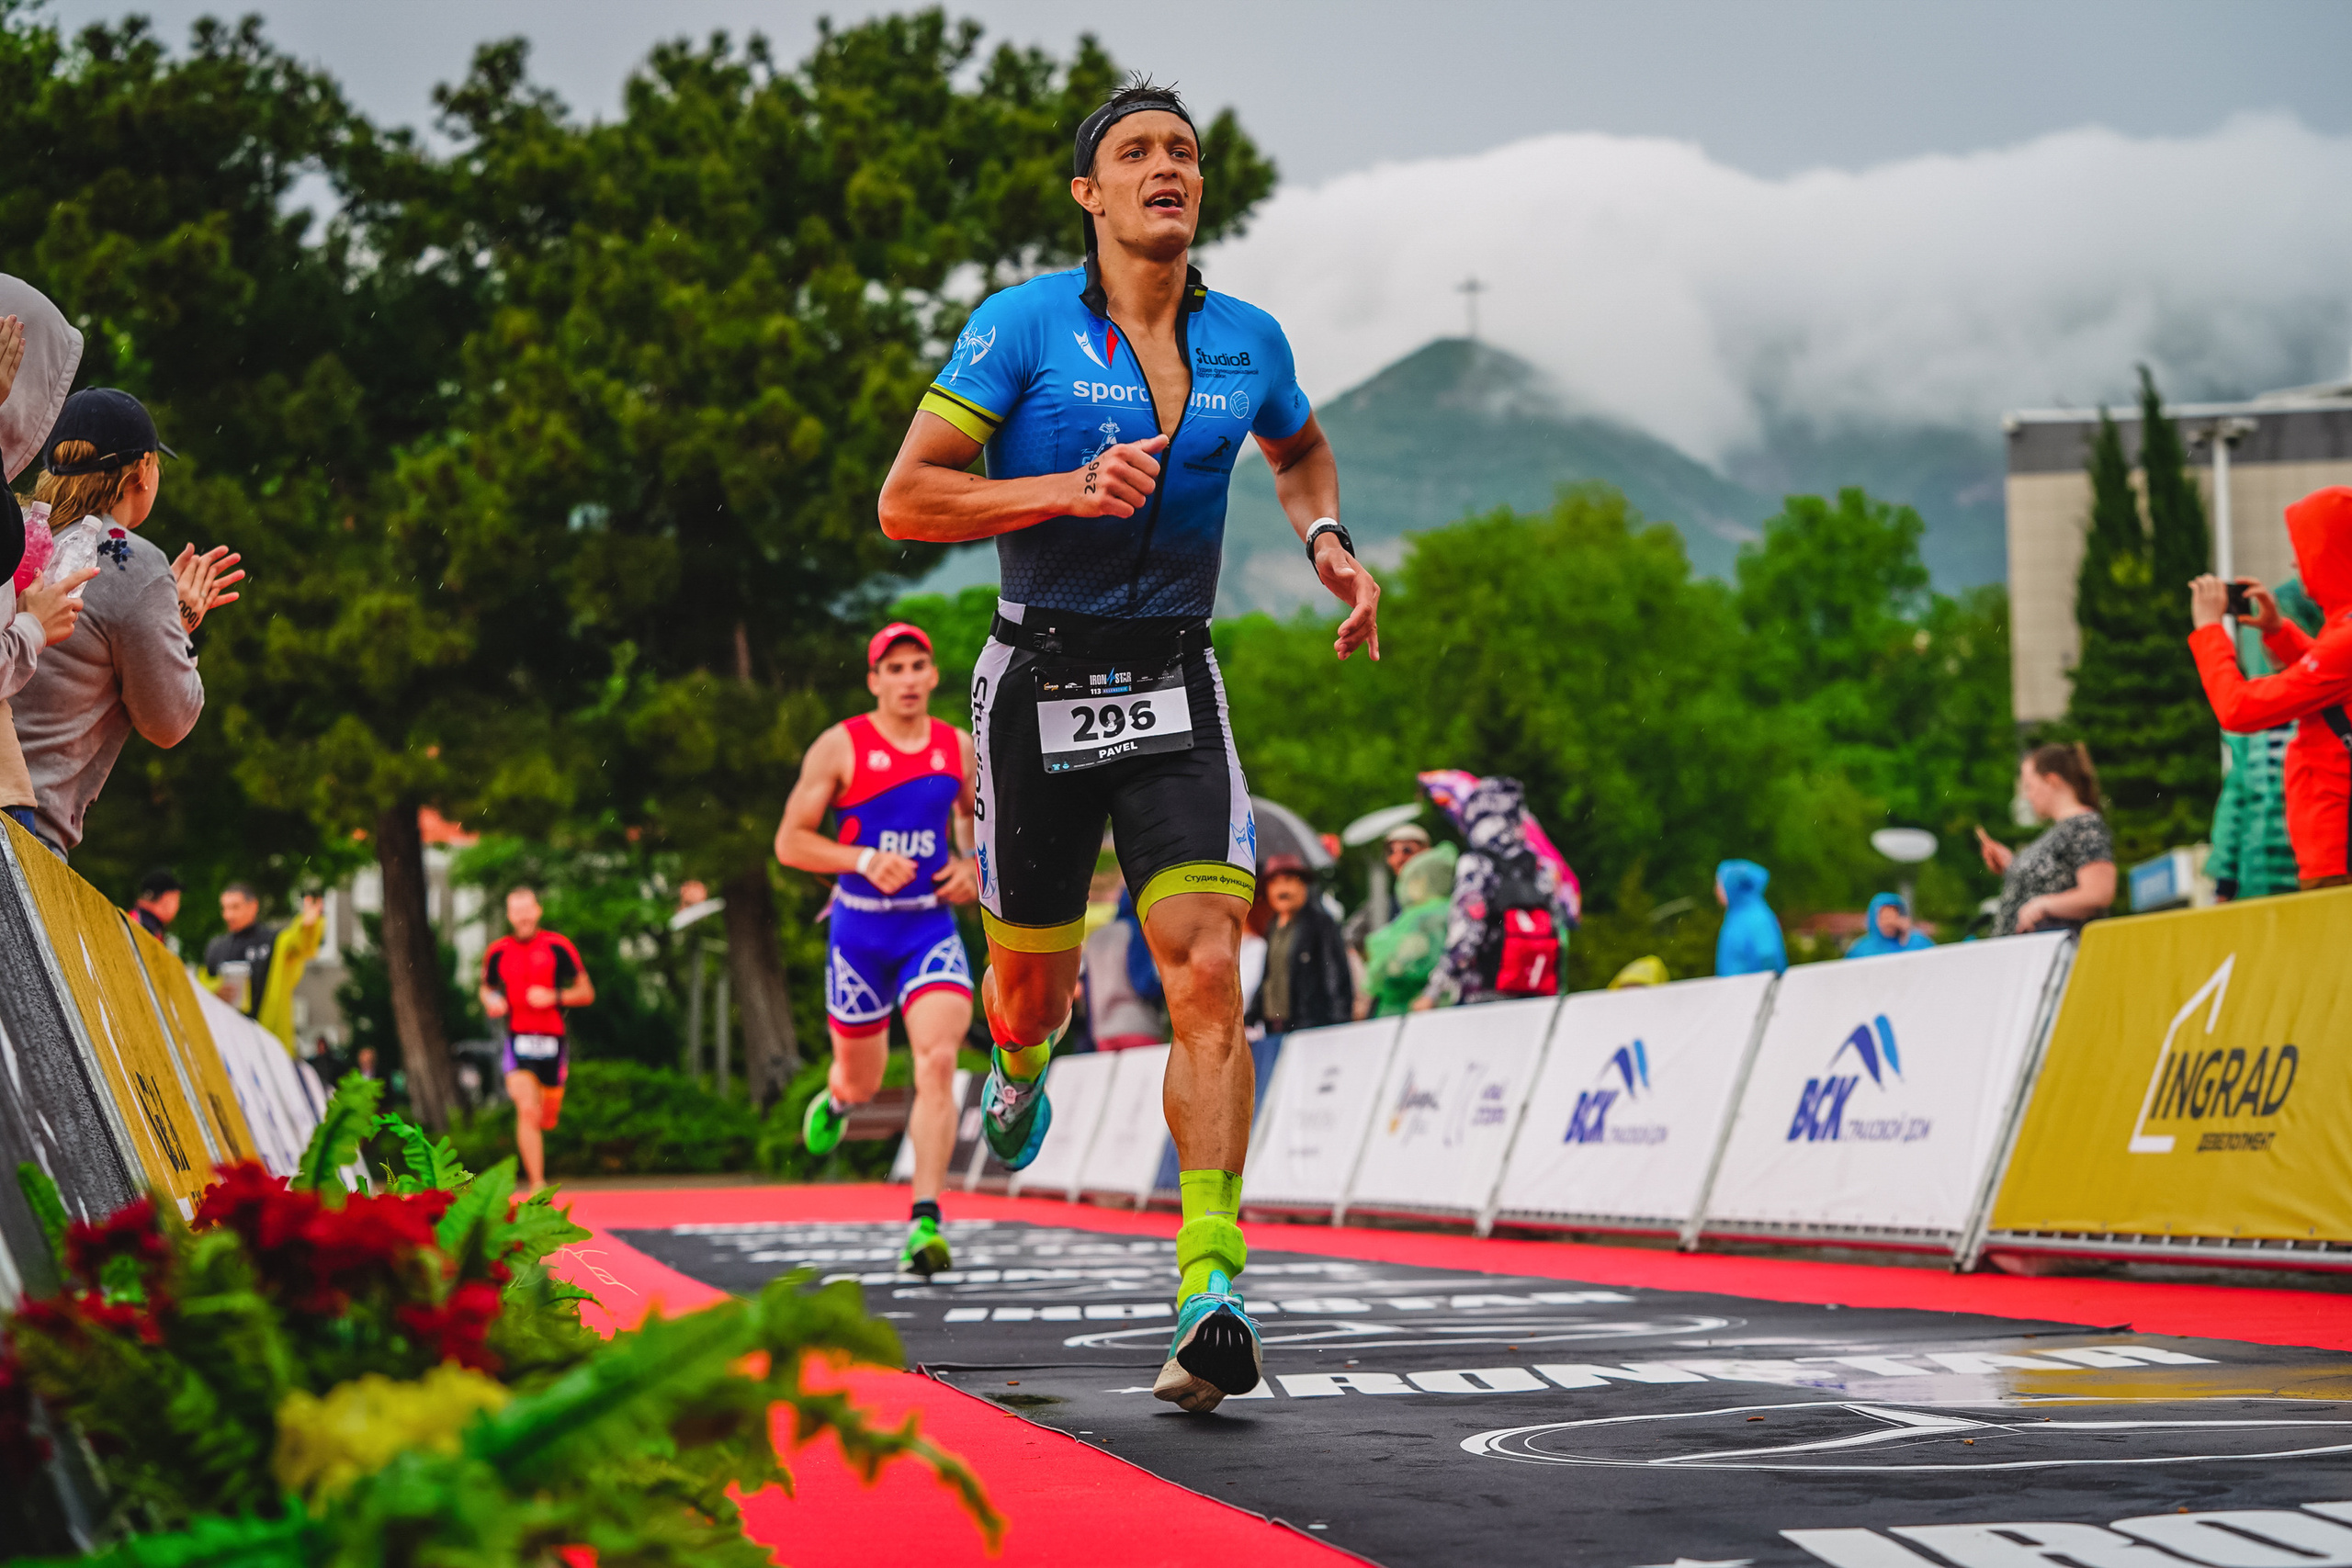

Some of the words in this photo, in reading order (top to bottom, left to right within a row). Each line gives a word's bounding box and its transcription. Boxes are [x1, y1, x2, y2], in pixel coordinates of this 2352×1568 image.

[1195, 347, 1251, 367] Studio8
[1073, 380, 1149, 403] sport
[1084, 461, 1100, 494] 296
[1090, 673, 1107, 686] IRON
[1114, 671, 1132, 683] STAR
[1070, 700, 1157, 743] 296
[1098, 741, 1138, 760] PAVEL
[1184, 874, 1218, 883] Студия
[2150, 1043, 2300, 1120] INGRAD
[1779, 1500, 2352, 1568] IRO
